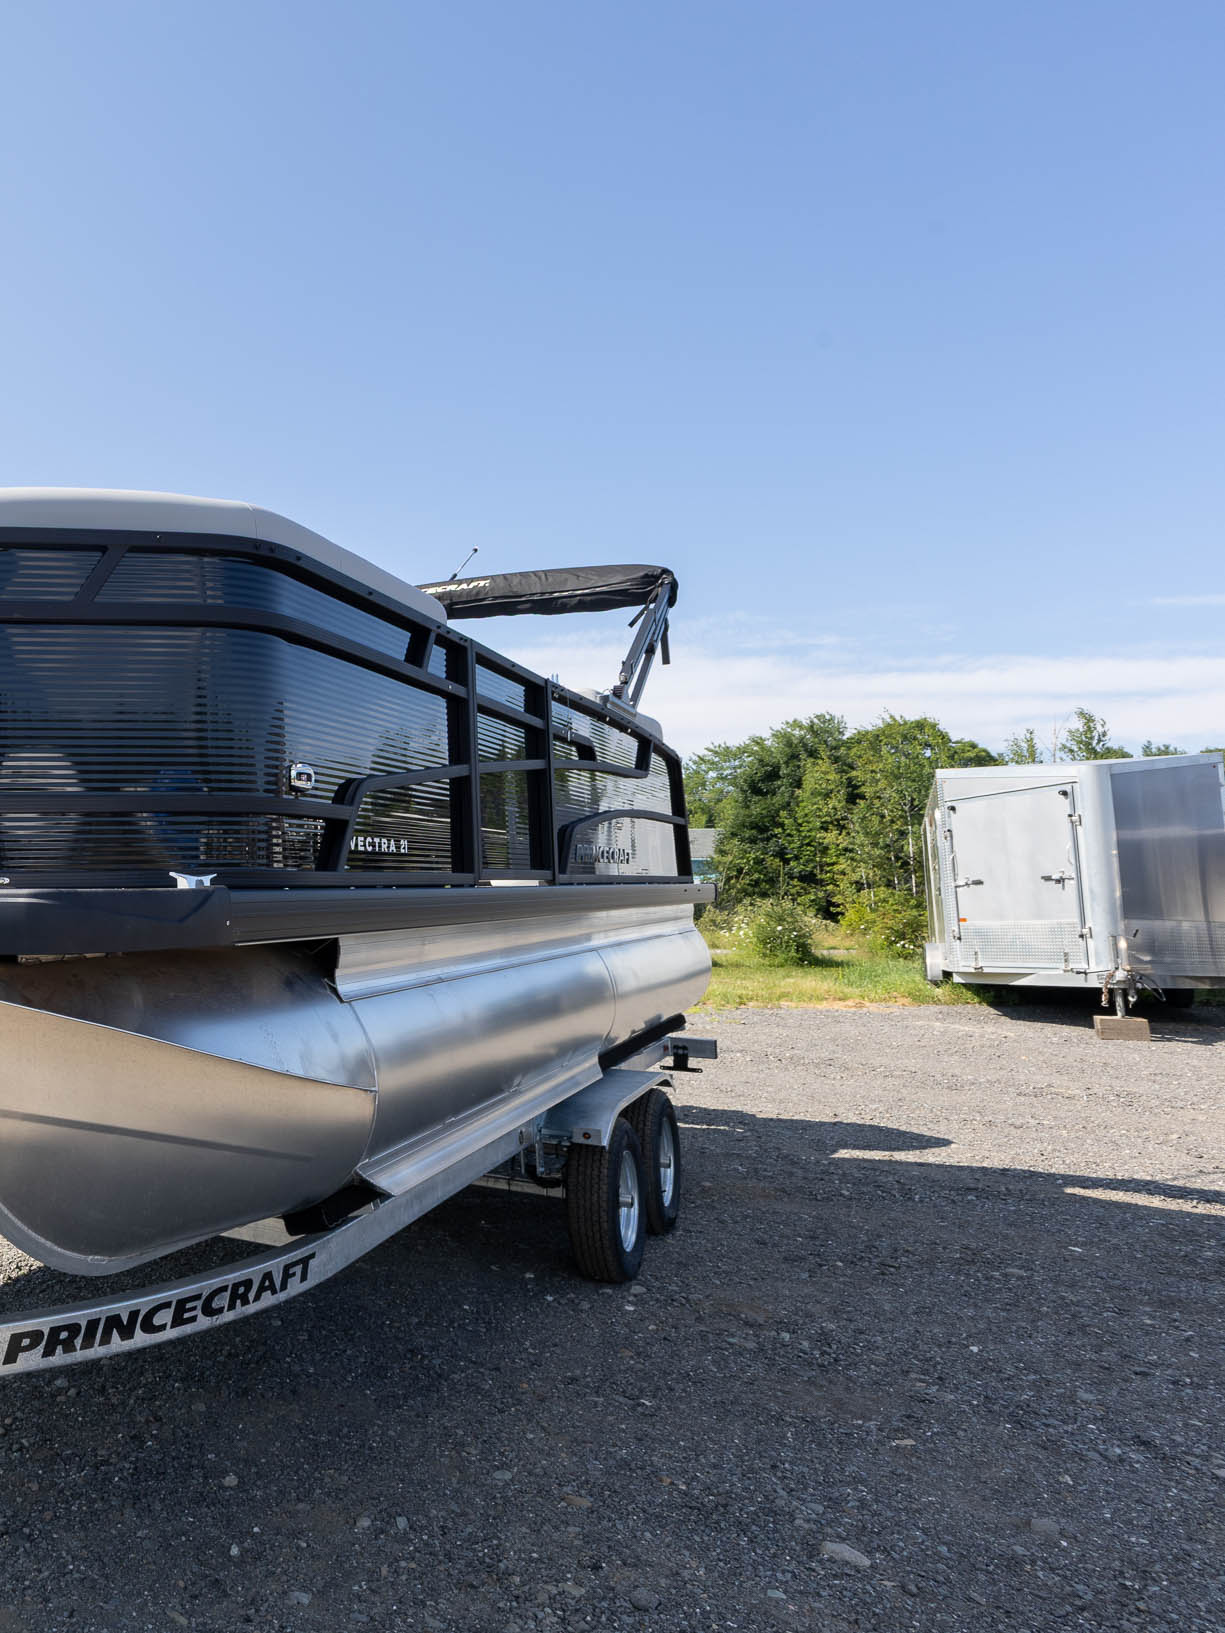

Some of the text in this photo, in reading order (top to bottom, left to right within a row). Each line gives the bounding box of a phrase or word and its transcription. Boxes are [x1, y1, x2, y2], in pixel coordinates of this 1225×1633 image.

[350, 835, 409, 854] VECTRA 21
[2, 1251, 317, 1366] PRINCECRAFT
